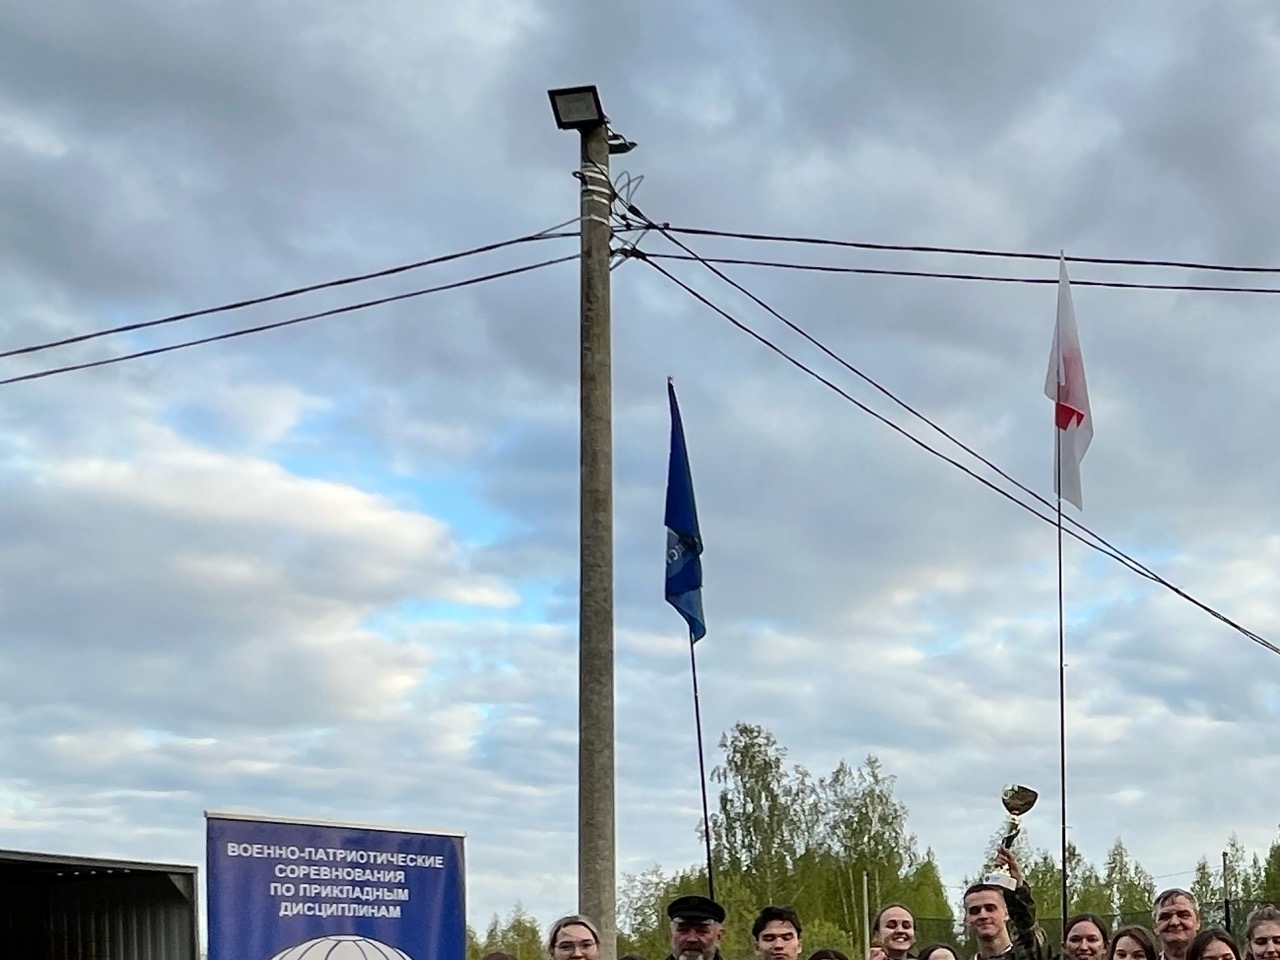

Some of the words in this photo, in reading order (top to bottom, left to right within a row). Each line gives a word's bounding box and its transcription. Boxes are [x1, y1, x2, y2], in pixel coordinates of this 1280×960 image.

[227, 842, 445, 869] ВОЕННО-ПАТРИОТИЧЕСКИЕ
[274, 863, 406, 884] СОРЕВНОВАНИЯ
[270, 883, 296, 898] ПО
[299, 884, 410, 902] ПРИКЛАДНЫМ
[278, 901, 402, 919] ДИСЦИПЛИНАМ
